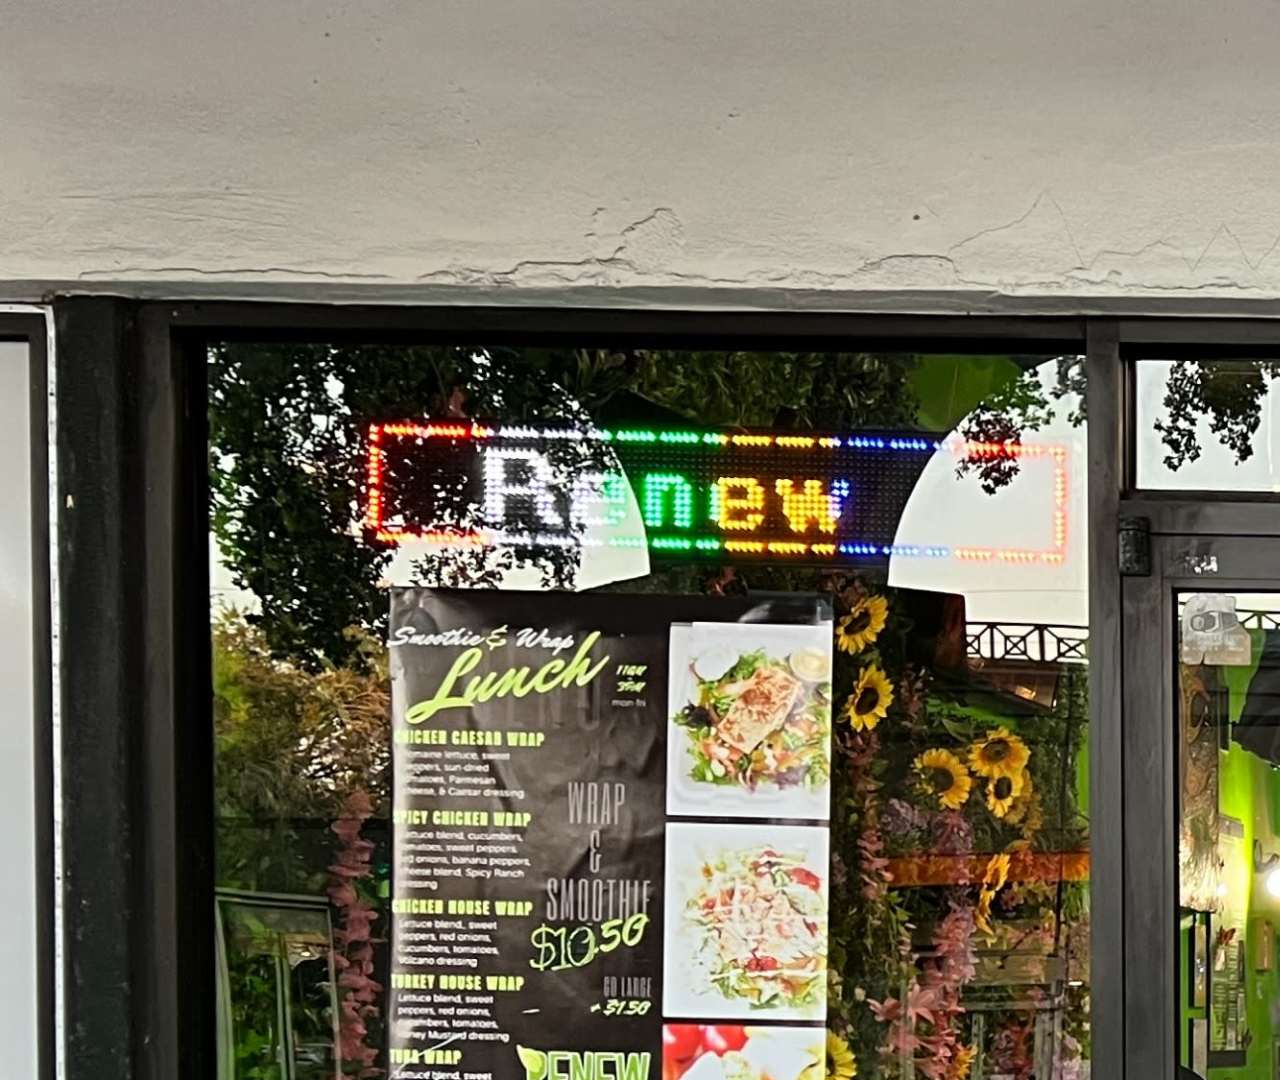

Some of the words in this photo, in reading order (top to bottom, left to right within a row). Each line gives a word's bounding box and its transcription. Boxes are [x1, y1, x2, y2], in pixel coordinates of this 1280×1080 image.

[484, 446, 850, 534] Renew
[387, 627, 486, 648] Smoothie
[516, 628, 575, 656] Wrap
[405, 631, 610, 724] Lunch
[452, 731, 502, 745] CAESAR
[507, 732, 545, 746] WRAP
[567, 782, 626, 825] WRAP
[433, 811, 488, 826] CHICKEN
[493, 812, 531, 827] WRAP
[448, 900, 490, 915] HOUSE
[495, 901, 533, 916] WRAP
[546, 878, 650, 922] SMOOTHIE
[391, 974, 435, 989] TURKEY
[439, 975, 481, 990] HOUSE
[486, 976, 525, 991] WRAP
[424, 1050, 462, 1065] WRAP
